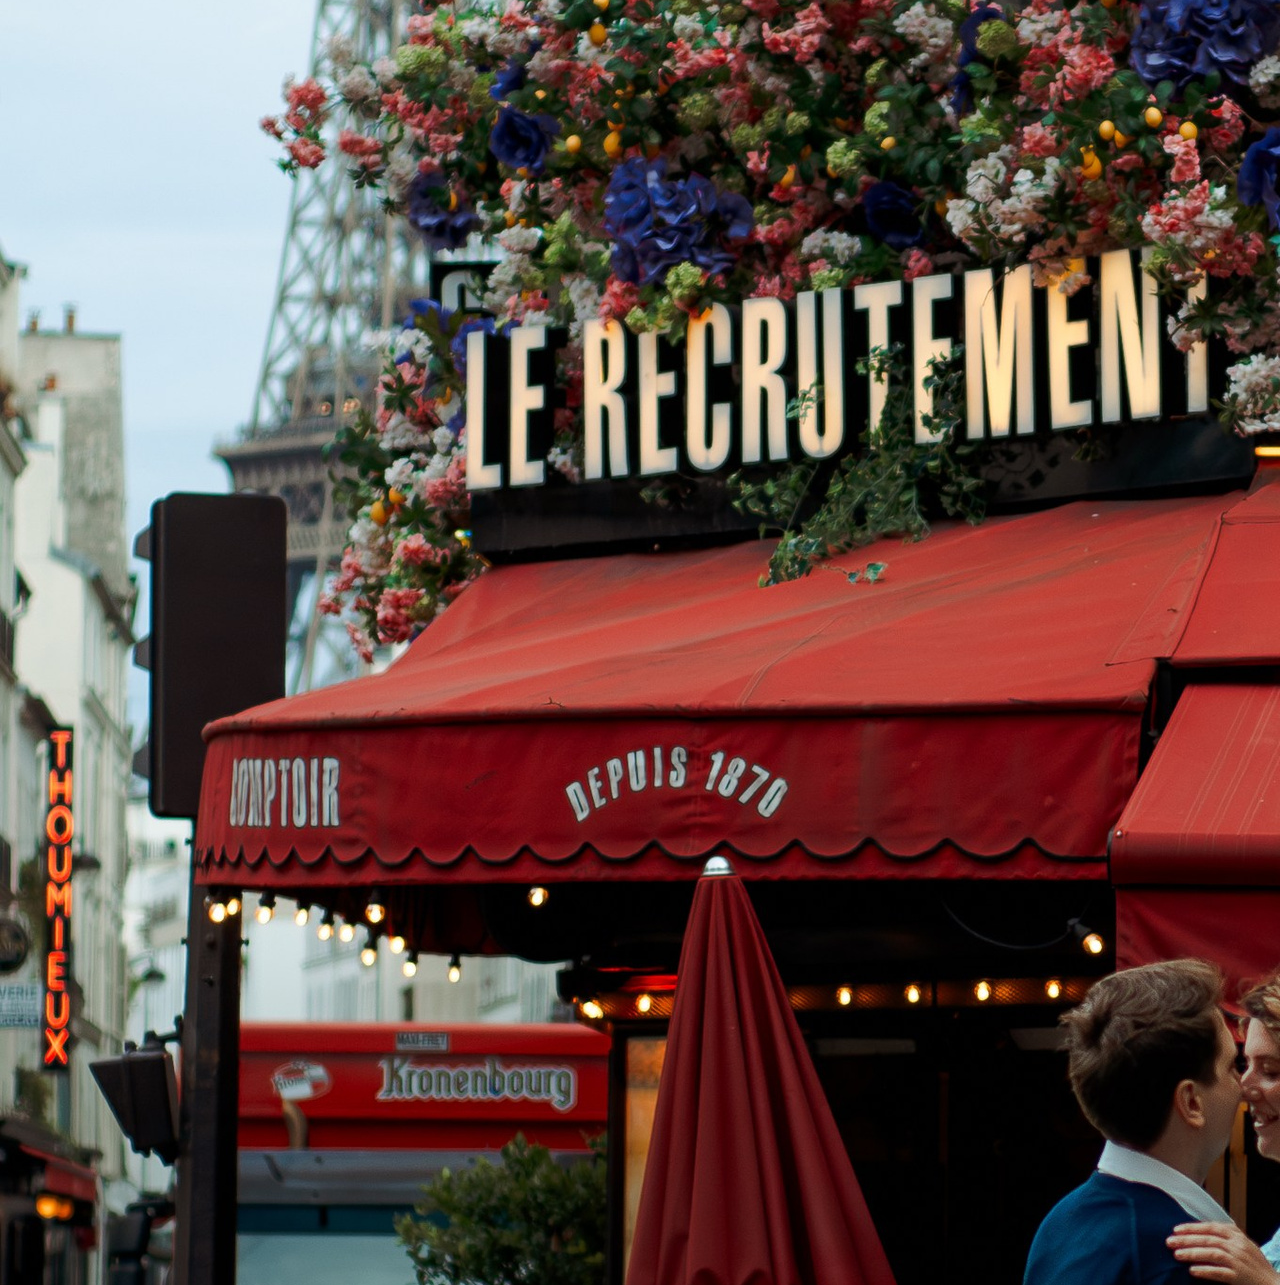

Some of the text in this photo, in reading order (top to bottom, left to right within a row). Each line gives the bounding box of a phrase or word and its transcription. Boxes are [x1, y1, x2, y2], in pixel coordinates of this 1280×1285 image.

[466, 326, 546, 490] LE
[229, 757, 340, 828] COMPTOIR
[565, 746, 789, 822] DEPUIS 1870
[45, 730, 73, 1065] THOUMIEUX
[376, 1056, 578, 1113] Kronenbourg
